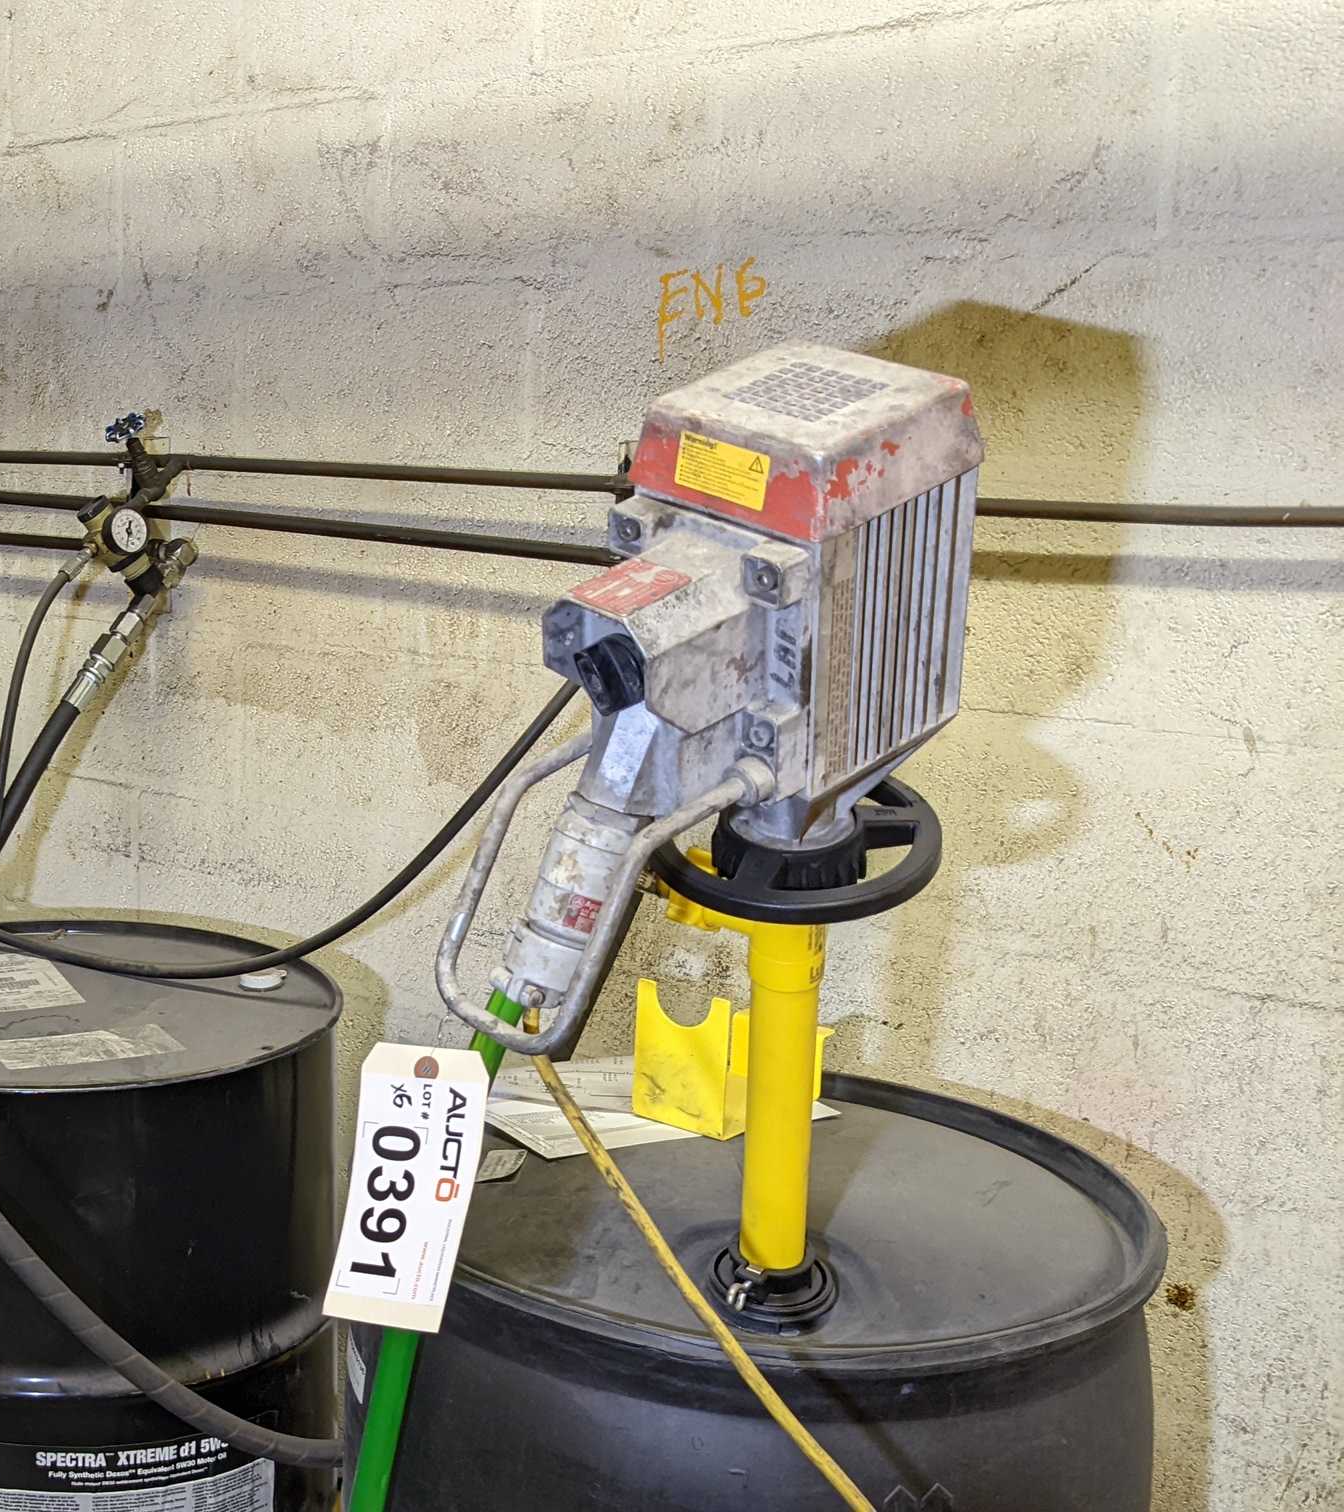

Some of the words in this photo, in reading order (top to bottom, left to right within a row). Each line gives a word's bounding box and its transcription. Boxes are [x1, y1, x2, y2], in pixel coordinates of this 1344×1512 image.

[422, 1084, 432, 1108] LOT
[420, 1112, 430, 1120] #
[350, 1125, 421, 1278] 0391
[35, 1452, 106, 1467] SPECTRA
[117, 1445, 178, 1465] XTREME
[179, 1440, 196, 1457] d1
[48, 1470, 67, 1479] Fully
[68, 1470, 104, 1479] Synthetic
[137, 1464, 174, 1475] Equivalent
